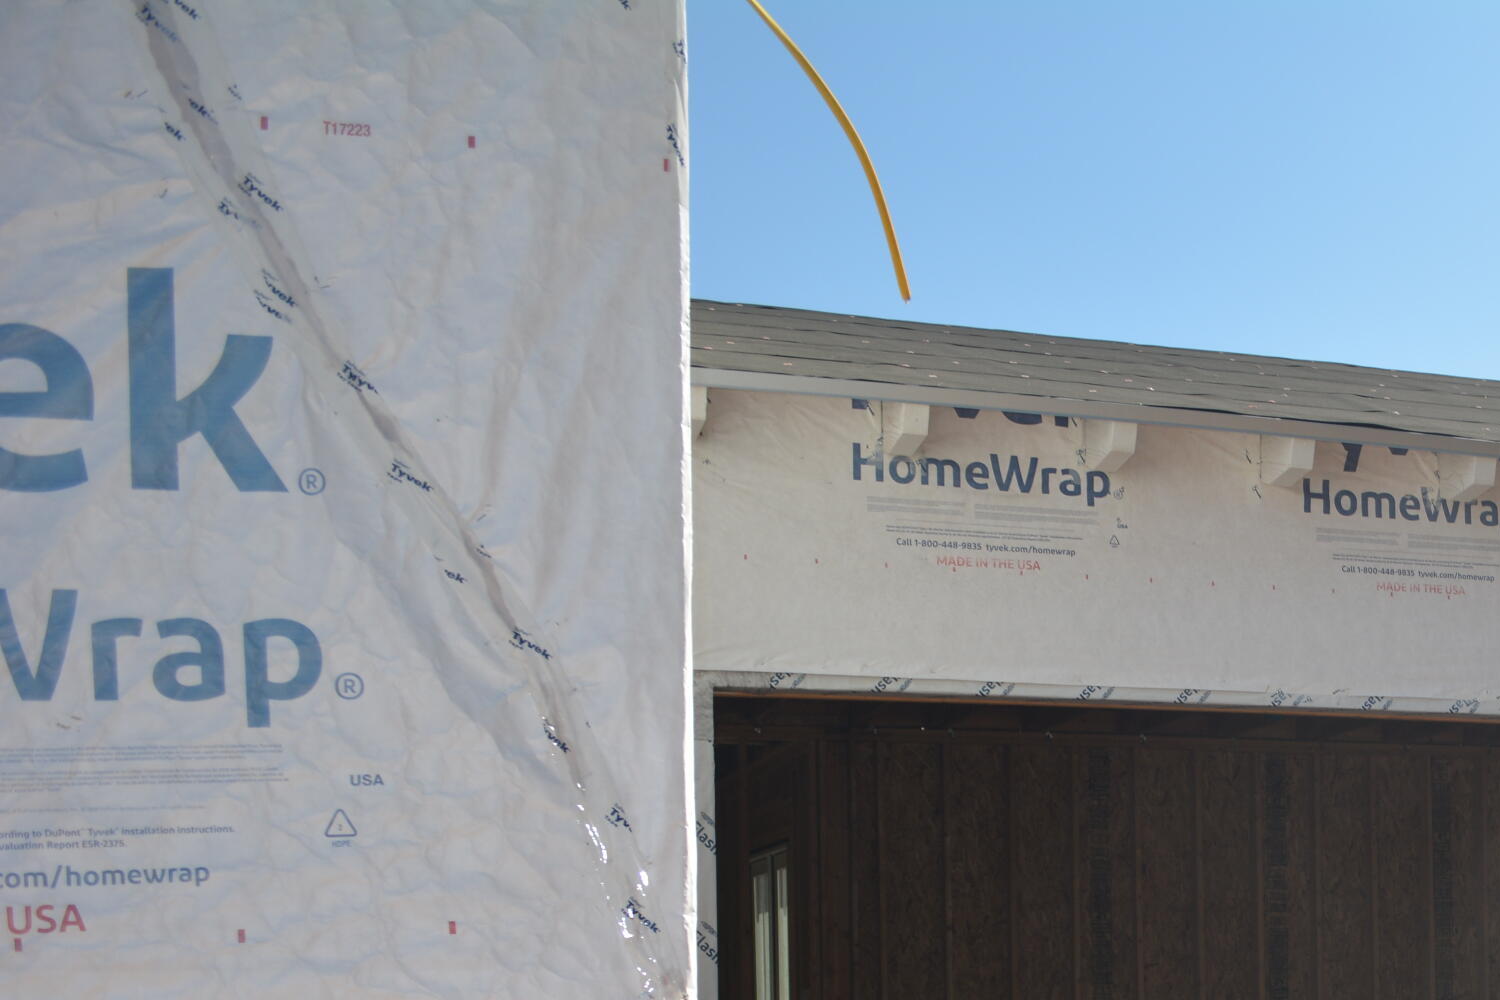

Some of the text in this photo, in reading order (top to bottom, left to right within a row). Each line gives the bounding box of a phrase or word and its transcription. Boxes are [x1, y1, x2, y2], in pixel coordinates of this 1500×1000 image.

[323, 120, 370, 136] T17223
[391, 462, 433, 493] Tyvek
[852, 442, 1110, 507] HomeWrap
[896, 538, 1076, 557] Call 1-800-448-9835 tyvek.com/homewrap
[937, 556, 1040, 571] MADE IN THE USA
[1342, 565, 1355, 573] Call
[1376, 582, 1465, 595] MADE IN THE USA
[511, 630, 552, 660] Tyvek
[350, 774, 384, 786] USA
[6, 904, 87, 935] USA
